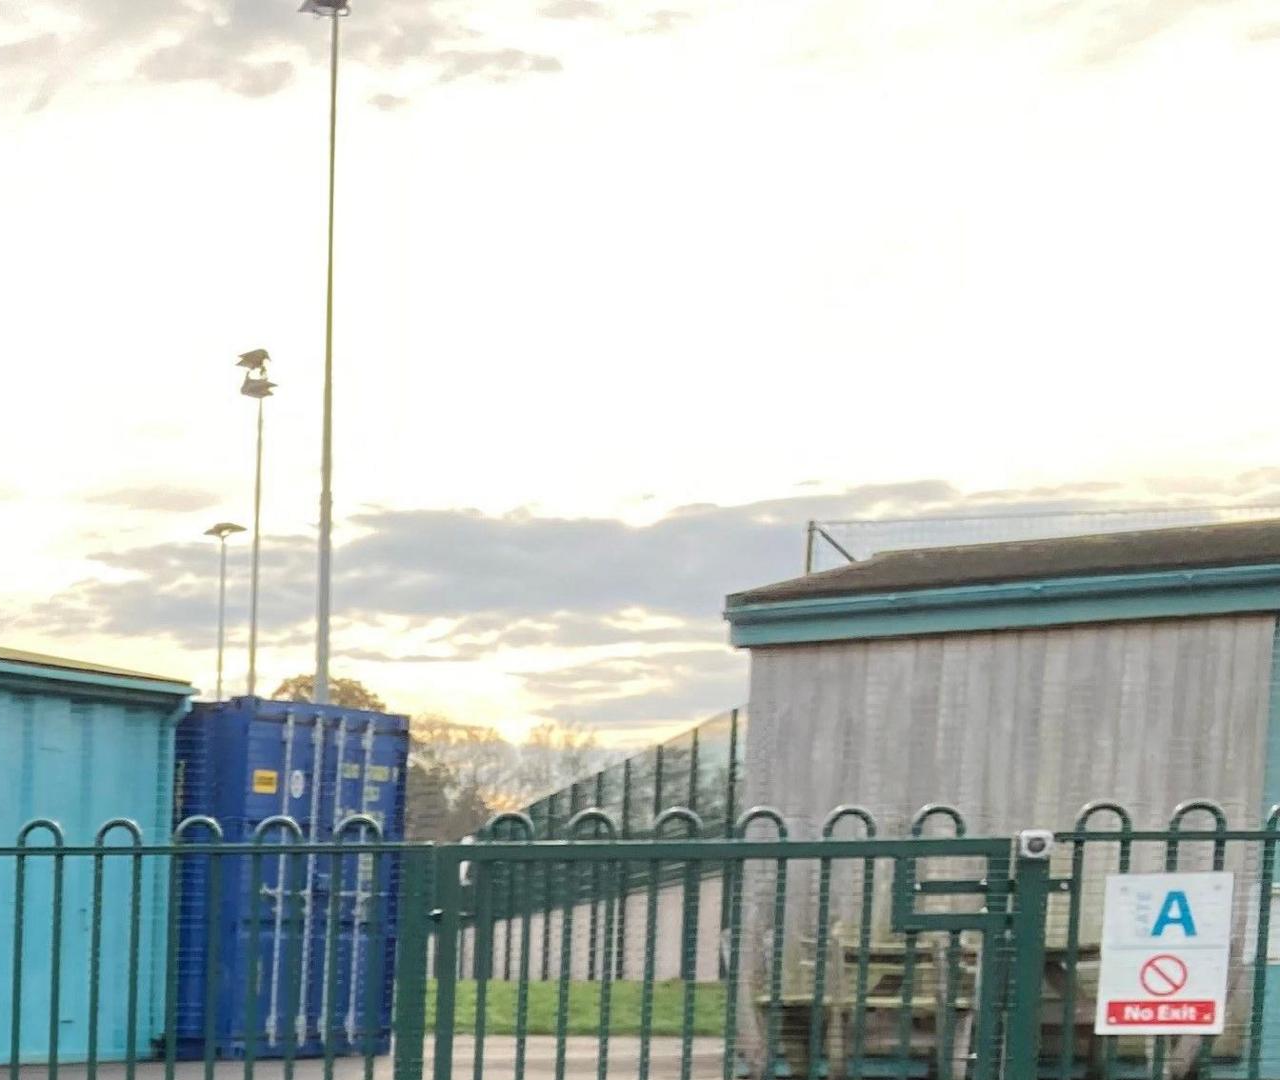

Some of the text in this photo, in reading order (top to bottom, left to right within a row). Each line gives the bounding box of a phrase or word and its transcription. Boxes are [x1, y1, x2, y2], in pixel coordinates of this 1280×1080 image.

[1150, 890, 1197, 937] A
[1123, 1003, 1197, 1021] No Exit
